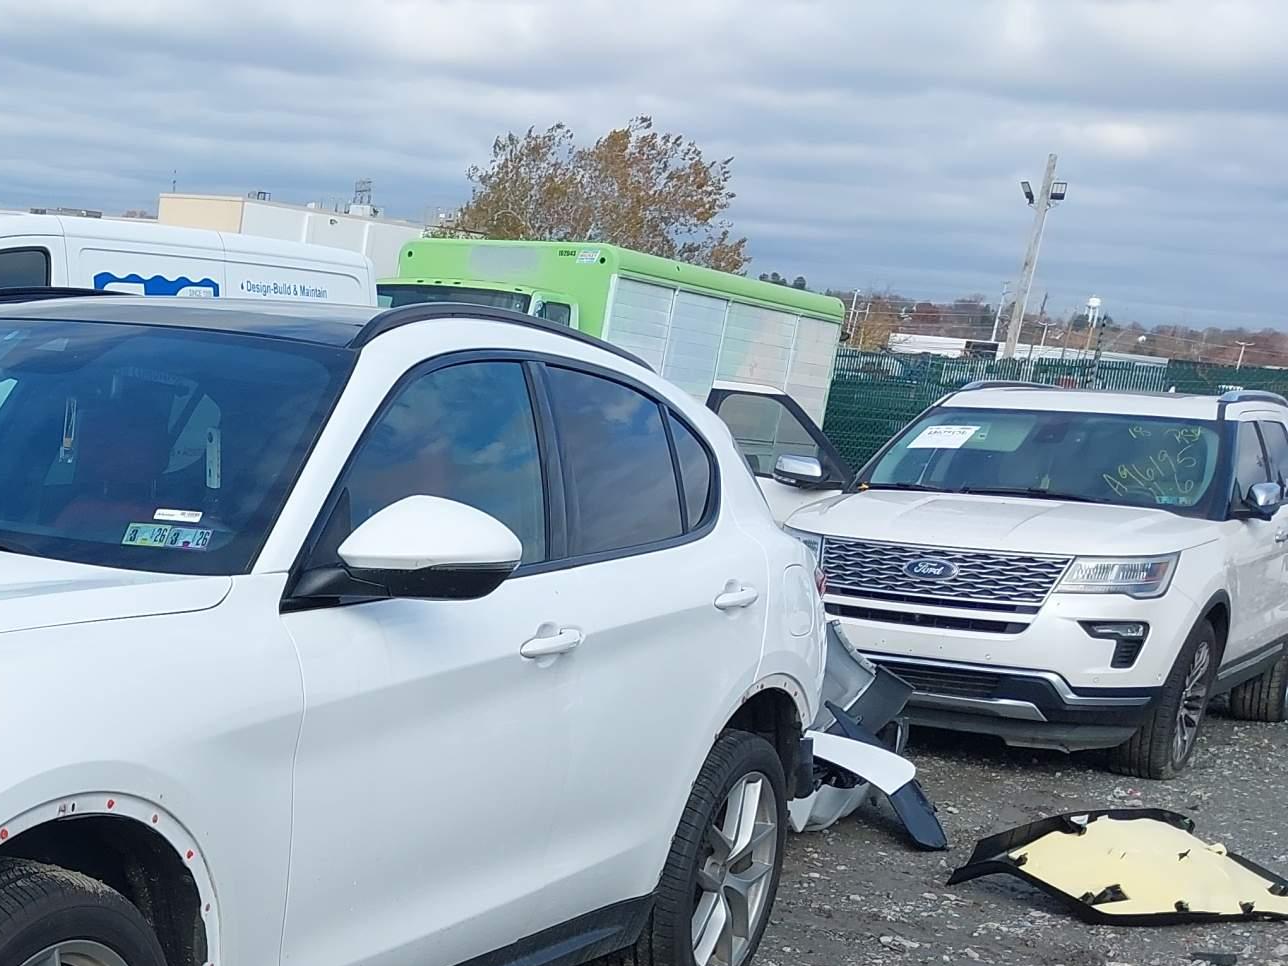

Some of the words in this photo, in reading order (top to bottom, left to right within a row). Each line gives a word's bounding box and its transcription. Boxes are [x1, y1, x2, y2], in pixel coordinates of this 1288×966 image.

[246, 280, 292, 297] Design-Build
[293, 284, 299, 296] &
[299, 284, 328, 299] Maintain
[914, 562, 945, 575] Ford
